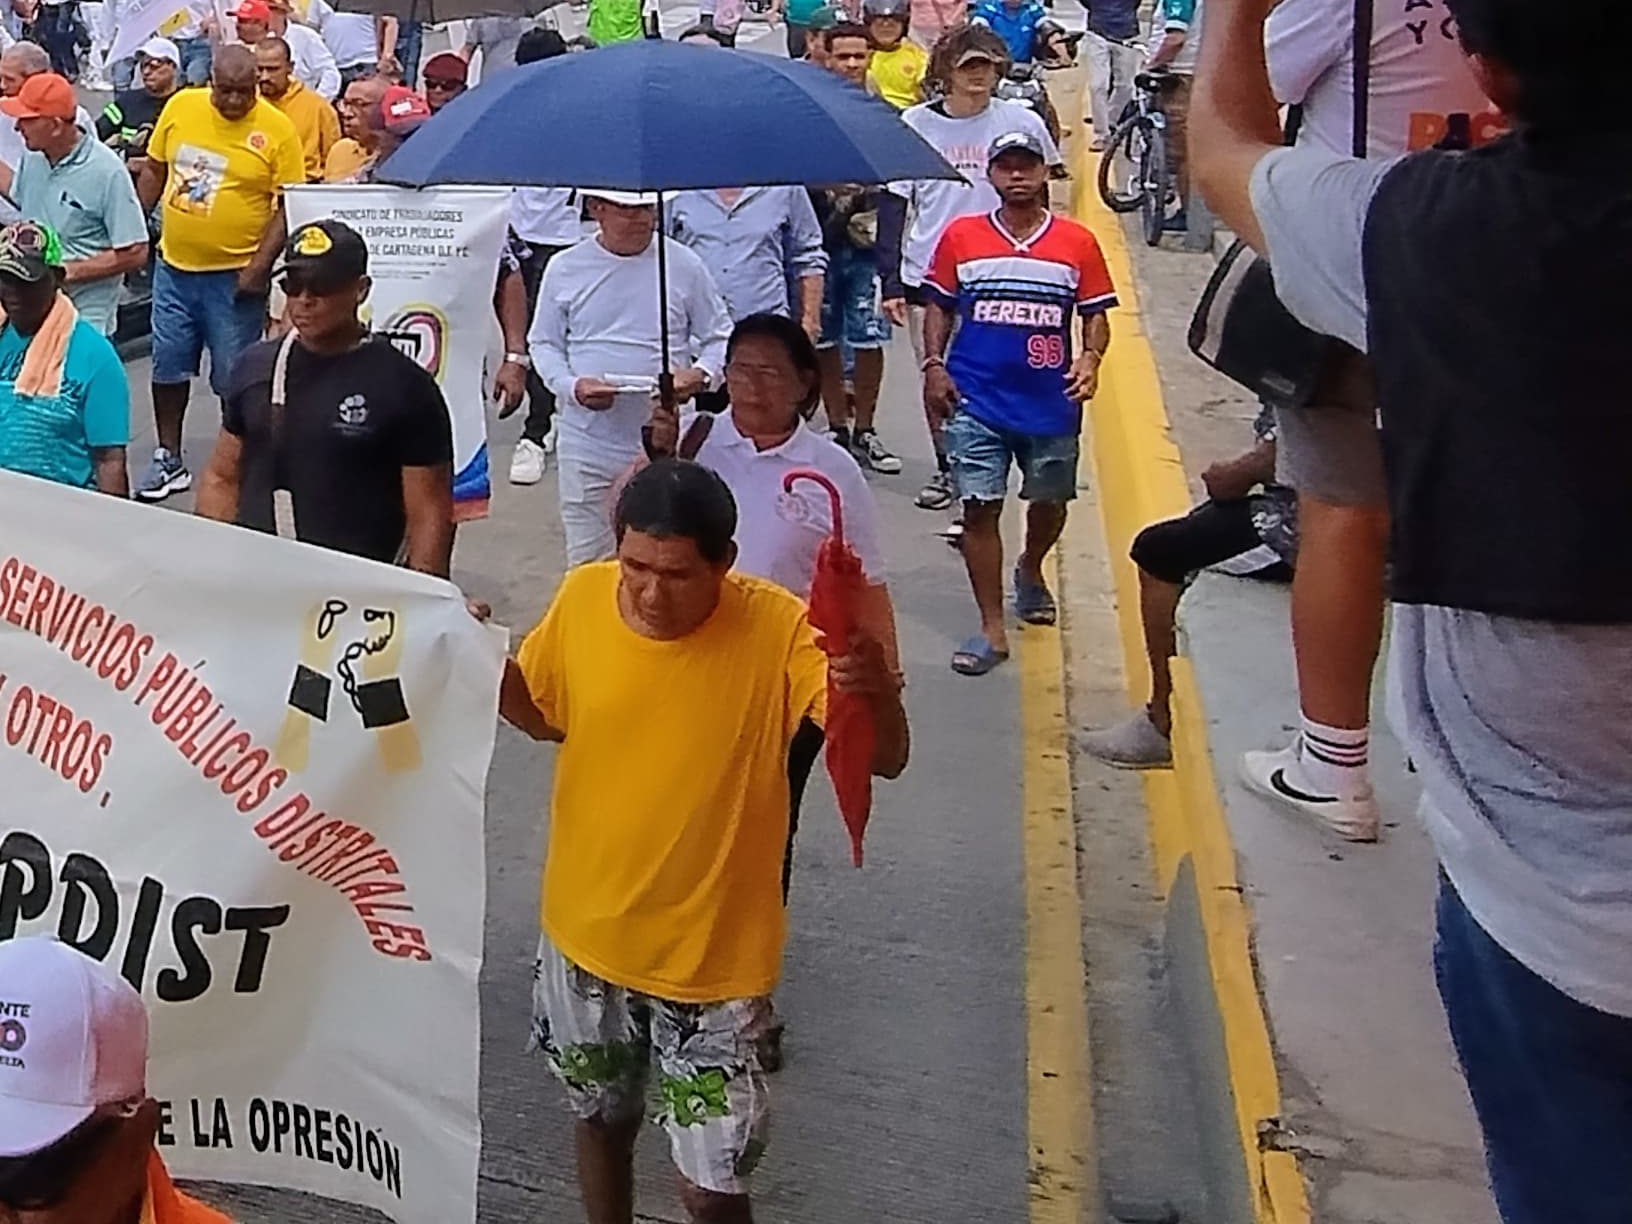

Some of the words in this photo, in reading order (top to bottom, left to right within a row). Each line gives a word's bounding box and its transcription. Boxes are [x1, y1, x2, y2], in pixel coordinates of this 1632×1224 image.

[133, 652, 288, 814] PÚBLICOS
[254, 792, 433, 962] DISTRITALES
[158, 1100, 176, 1146] E
[190, 1097, 234, 1149] LA
[248, 1097, 402, 1200] OPRESIÓN
